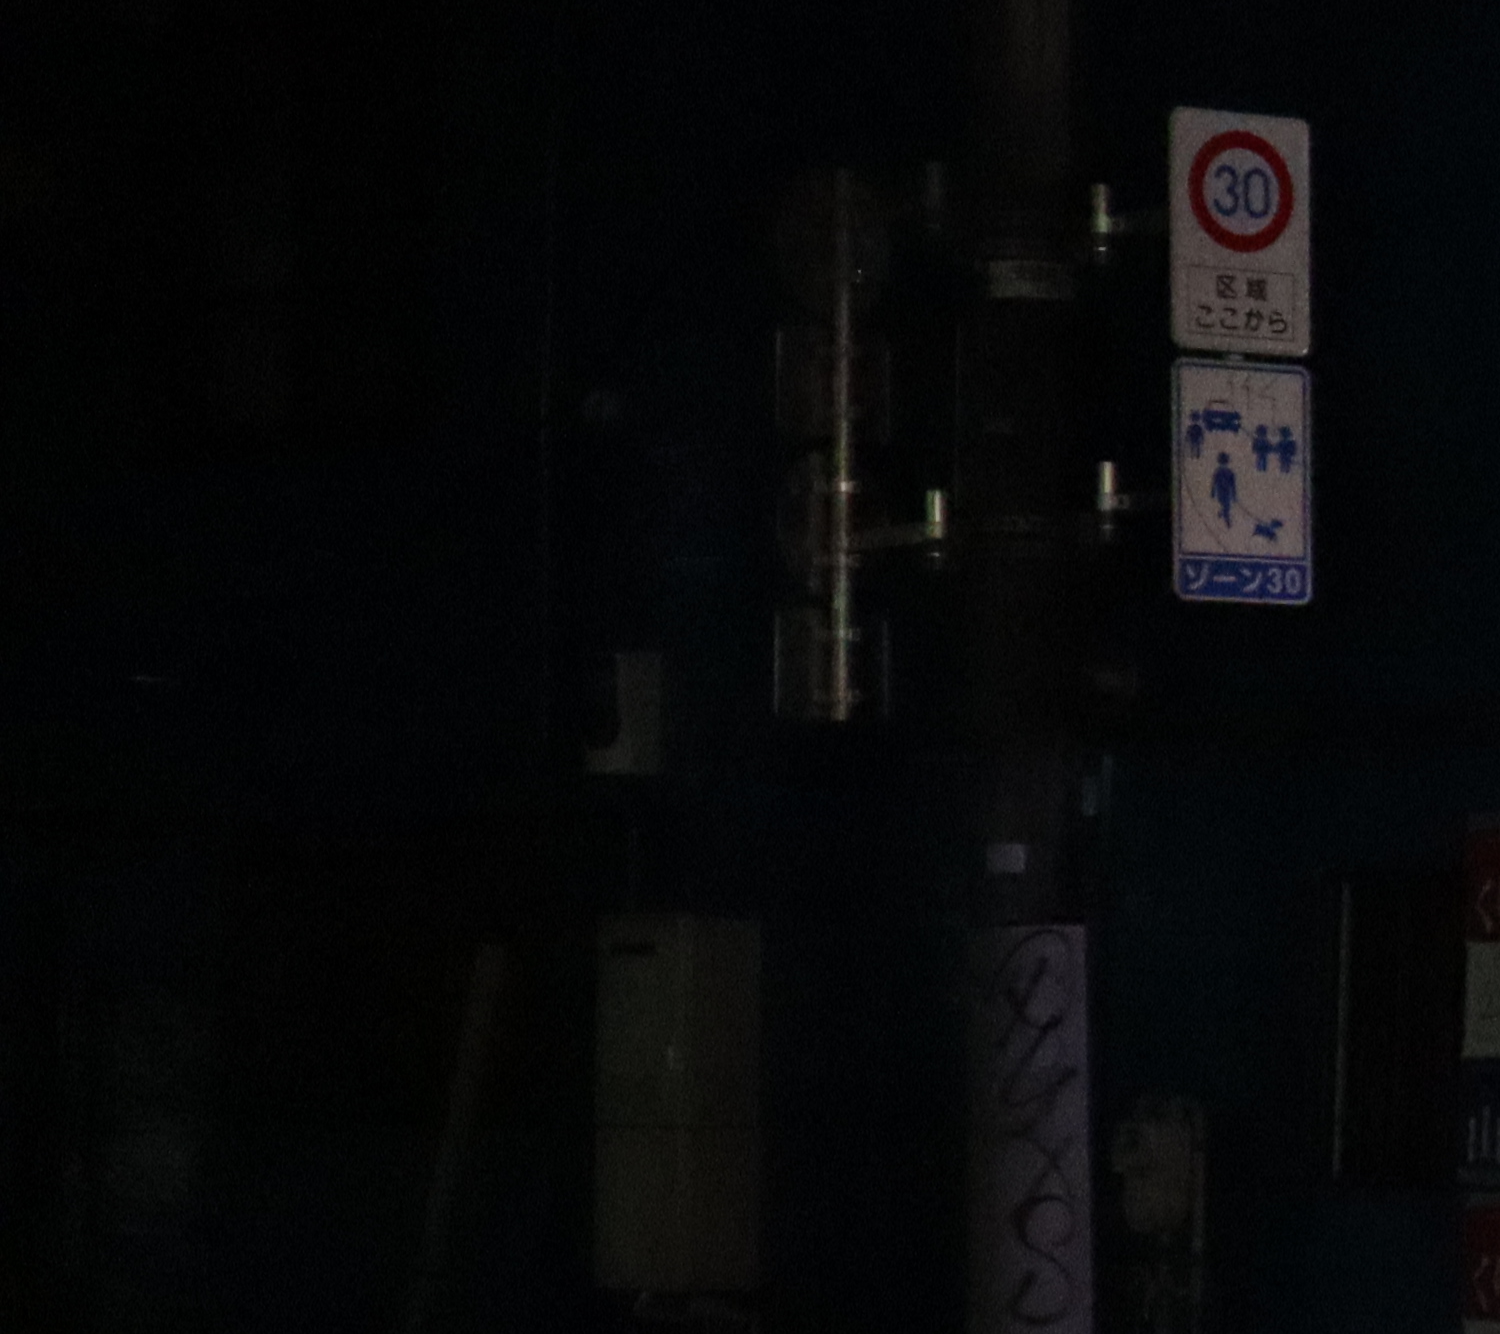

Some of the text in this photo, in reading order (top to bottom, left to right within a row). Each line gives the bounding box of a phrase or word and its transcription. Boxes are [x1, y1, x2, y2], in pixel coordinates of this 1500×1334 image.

[1214, 164, 1270, 218] 30
[1195, 304, 1288, 334] ここから
